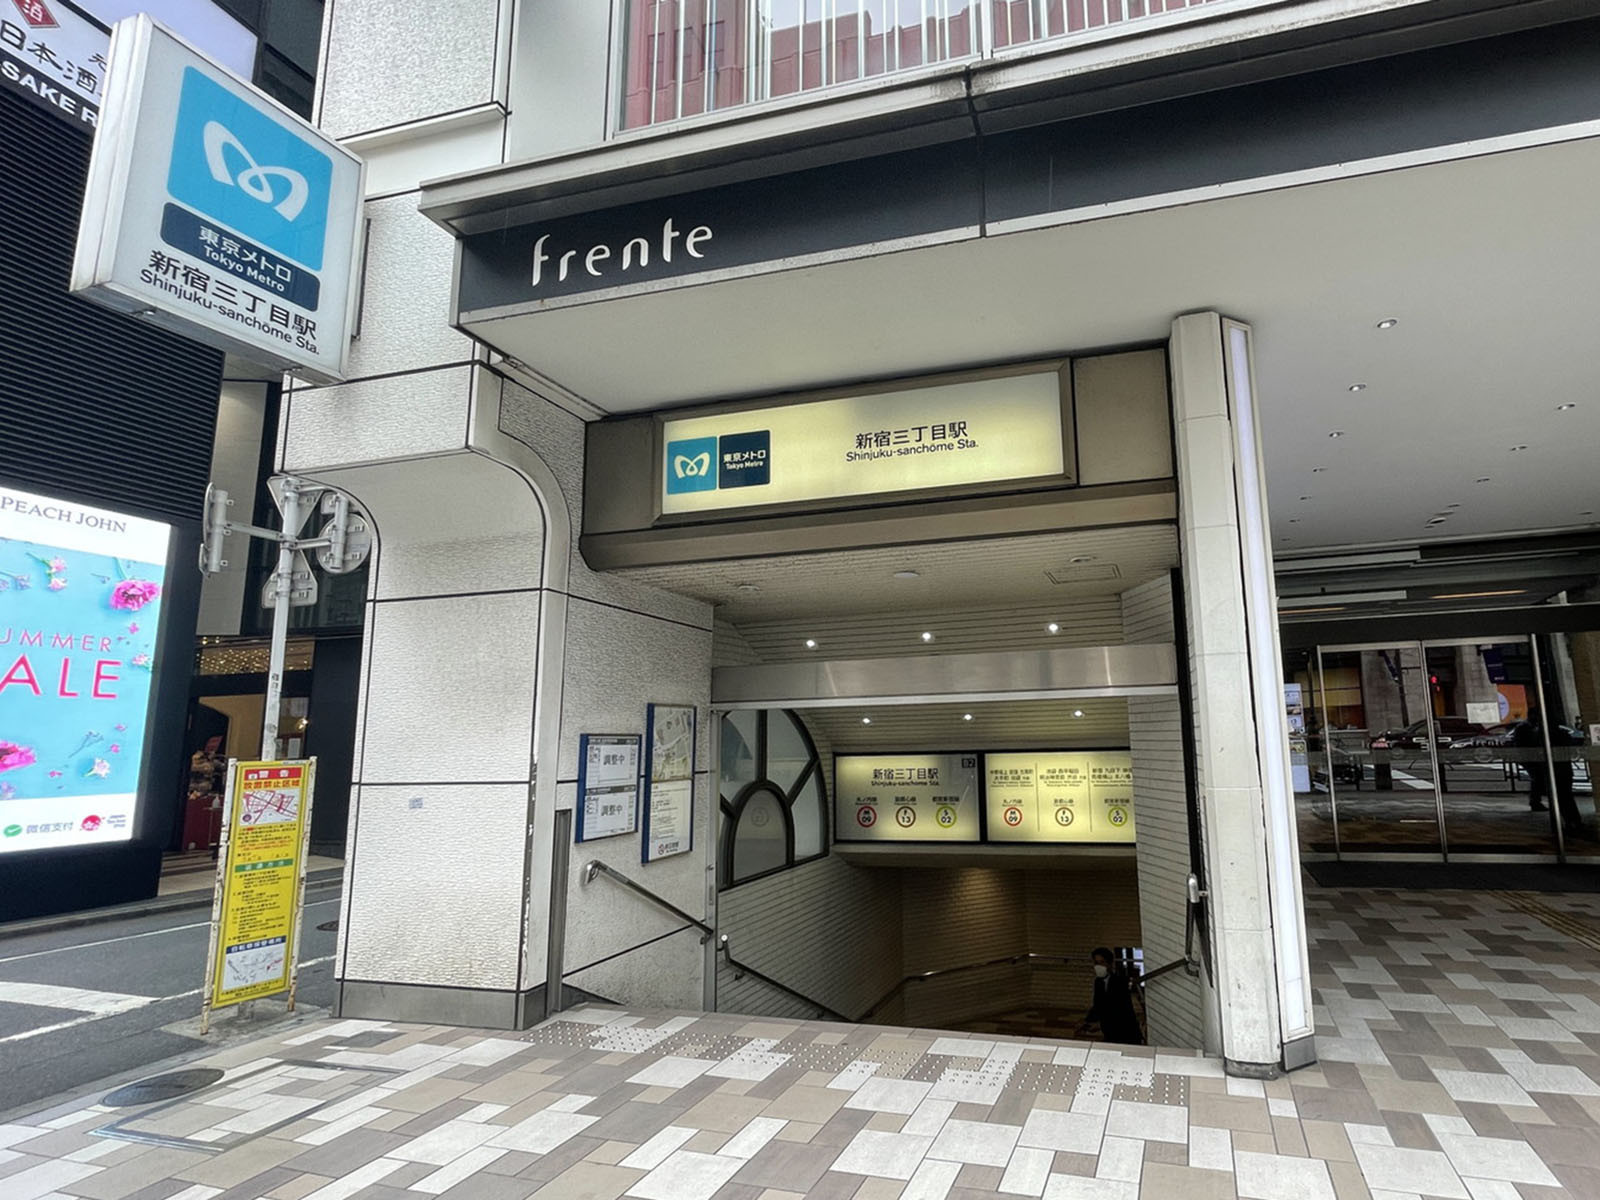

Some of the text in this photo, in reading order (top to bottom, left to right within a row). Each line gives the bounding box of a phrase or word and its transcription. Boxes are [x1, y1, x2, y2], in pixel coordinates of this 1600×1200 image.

[0, 60, 77, 115] SAKE
[199, 225, 292, 282] 東京メトロ
[532, 217, 713, 287] frente
[203, 245, 285, 292] Tokyo Metro
[149, 250, 317, 341] 新宿三丁目駅
[295, 335, 320, 355] Sta.
[855, 421, 969, 449] 新宿三丁目駅
[957, 438, 979, 449] Sta.
[723, 449, 767, 463] 東京メトロ
[726, 460, 764, 470] Tokyo Metro
[0, 496, 127, 532] PEACH JOHN
[0, 655, 122, 698] ALE
[603, 754, 625, 766] 調整中
[873, 768, 939, 780] 新宿三丁目駅
[601, 805, 623, 817] 調整中
